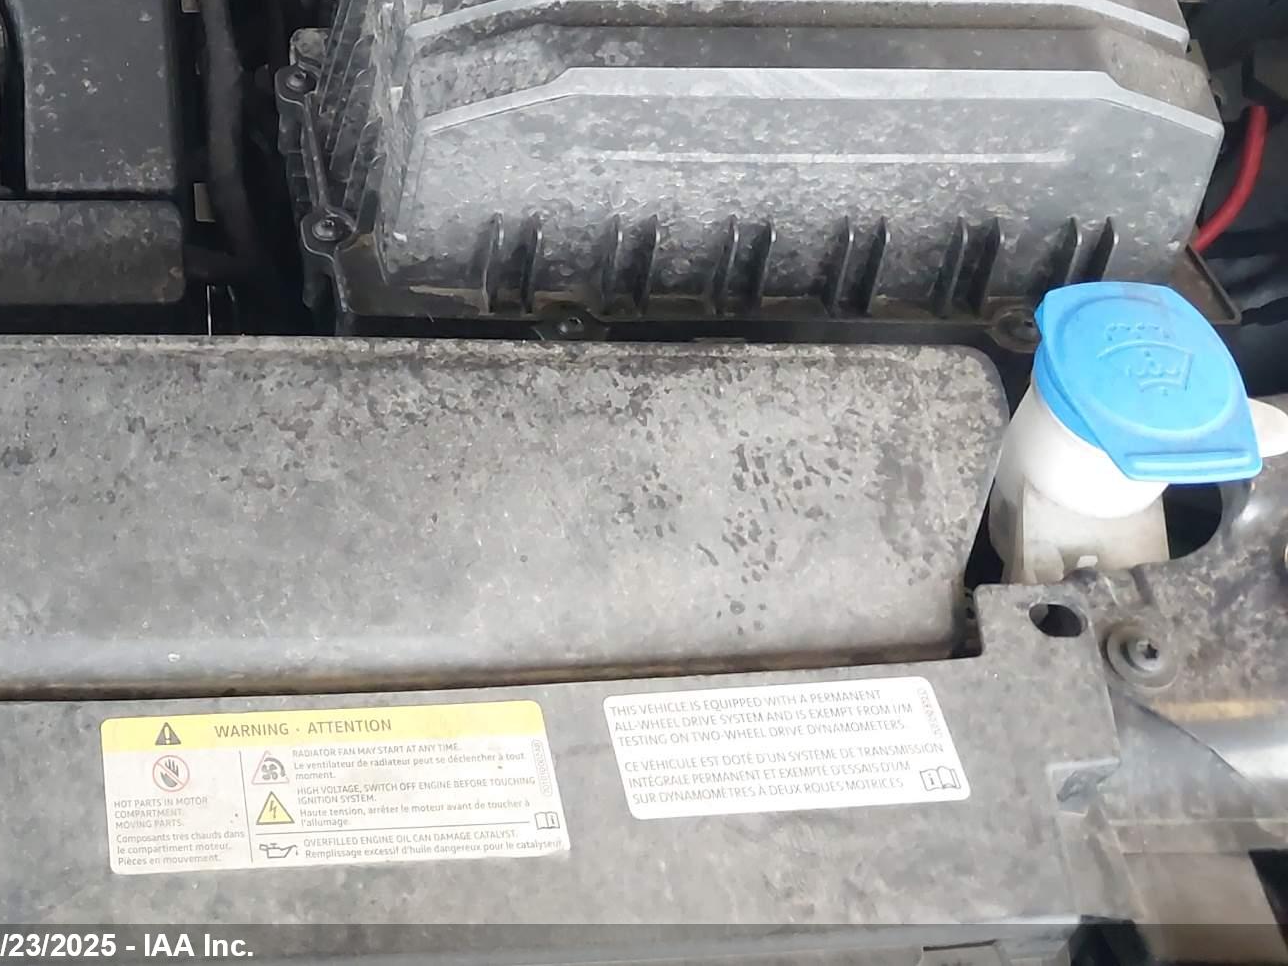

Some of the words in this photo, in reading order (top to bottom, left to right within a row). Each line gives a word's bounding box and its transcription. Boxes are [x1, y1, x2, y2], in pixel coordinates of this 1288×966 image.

[610, 705, 636, 716] THIS
[638, 703, 688, 714] VEHICLE
[691, 702, 700, 710] IS
[704, 698, 762, 711] EQUIPPED
[766, 694, 796, 706] WITH
[800, 694, 808, 703] A
[810, 690, 881, 703] PERMANENT
[615, 718, 680, 731] ALL-WHEEL
[682, 715, 718, 726] DRIVE
[720, 712, 763, 724] SYSTEM
[767, 711, 793, 721] AND
[796, 710, 806, 720] IS
[808, 706, 853, 719] EXEMPT
[857, 705, 890, 715] FROM
[894, 703, 912, 714] I/M
[214, 723, 289, 738] WARNING
[308, 719, 392, 734] ATTENTION
[619, 734, 668, 746] TESTING
[670, 733, 688, 744] ON
[692, 728, 765, 742] TWO-WHEEL
[768, 726, 804, 737] DRIVE
[807, 720, 905, 734] DYNAMOMETERS
[292, 749, 336, 758] RADIATOR
[338, 748, 355, 756] FAN
[358, 747, 376, 755] MAY
[378, 746, 404, 754] START
[406, 745, 417, 753] AT
[418, 744, 436, 752] ANY
[625, 762, 638, 772] CE
[700, 756, 720, 766] EST
[722, 752, 752, 766] DOTÉ
[756, 752, 785, 764] D'UN
[840, 747, 856, 758] DE
[858, 742, 944, 758] TRANSMISSION
[294, 762, 304, 770] Le
[306, 760, 354, 770] ventilateur
[356, 759, 368, 767] de
[370, 758, 410, 766] radiateur
[414, 757, 433, 766] peut
[435, 756, 445, 764] se
[448, 754, 496, 764] déclencher
[506, 752, 524, 760] tout
[296, 772, 336, 780] moment.
[693, 770, 760, 784] PERMANENT
[763, 769, 776, 778] ET
[832, 762, 879, 776] D'ESSAIS
[297, 786, 318, 794] HIGH
[320, 784, 362, 794] VOLTAGE,
[364, 783, 398, 792] SWITCH
[400, 782, 416, 790] OFF
[418, 780, 452, 790] ENGINE
[454, 778, 487, 788] BEFORE
[490, 777, 536, 786] TOUCHING
[632, 793, 656, 804] SUR
[768, 783, 802, 795] DEUX
[805, 780, 841, 793] ROUES
[845, 778, 904, 791] MOTRICES
[114, 800, 132, 808] HOT
[134, 798, 162, 807] PARTS
[164, 797, 174, 806] IN
[176, 796, 208, 806] MOTOR
[298, 796, 338, 805] IGNITION
[340, 794, 377, 803] SYSTEM.
[300, 808, 328, 816] Haute
[330, 807, 366, 816] tension,
[412, 803, 444, 812] moteur
[447, 802, 472, 810] avant
[488, 800, 522, 809] toucher
[116, 819, 152, 830] MOVING
[154, 818, 184, 828] PARTS.
[116, 833, 171, 844] Composants
[191, 830, 222, 840] chauds
[224, 830, 245, 838] dans
[304, 837, 358, 847] OVERFILLED
[361, 836, 394, 844] ENGINE
[396, 834, 412, 843] OIL
[412, 834, 432, 842] CAN
[434, 832, 471, 841] DAMAGE
[474, 830, 518, 840] CATALYST.
[117, 846, 126, 854] le
[128, 844, 193, 856] compartiment
[195, 842, 232, 852] moteur.
[306, 848, 362, 859] Remplissage
[364, 846, 398, 855] excessif
[402, 845, 432, 854] d'huile
[434, 844, 482, 855] dangereux
[484, 843, 504, 852] pour
[118, 856, 147, 866] Pièces
[162, 854, 222, 864] mouvement.
